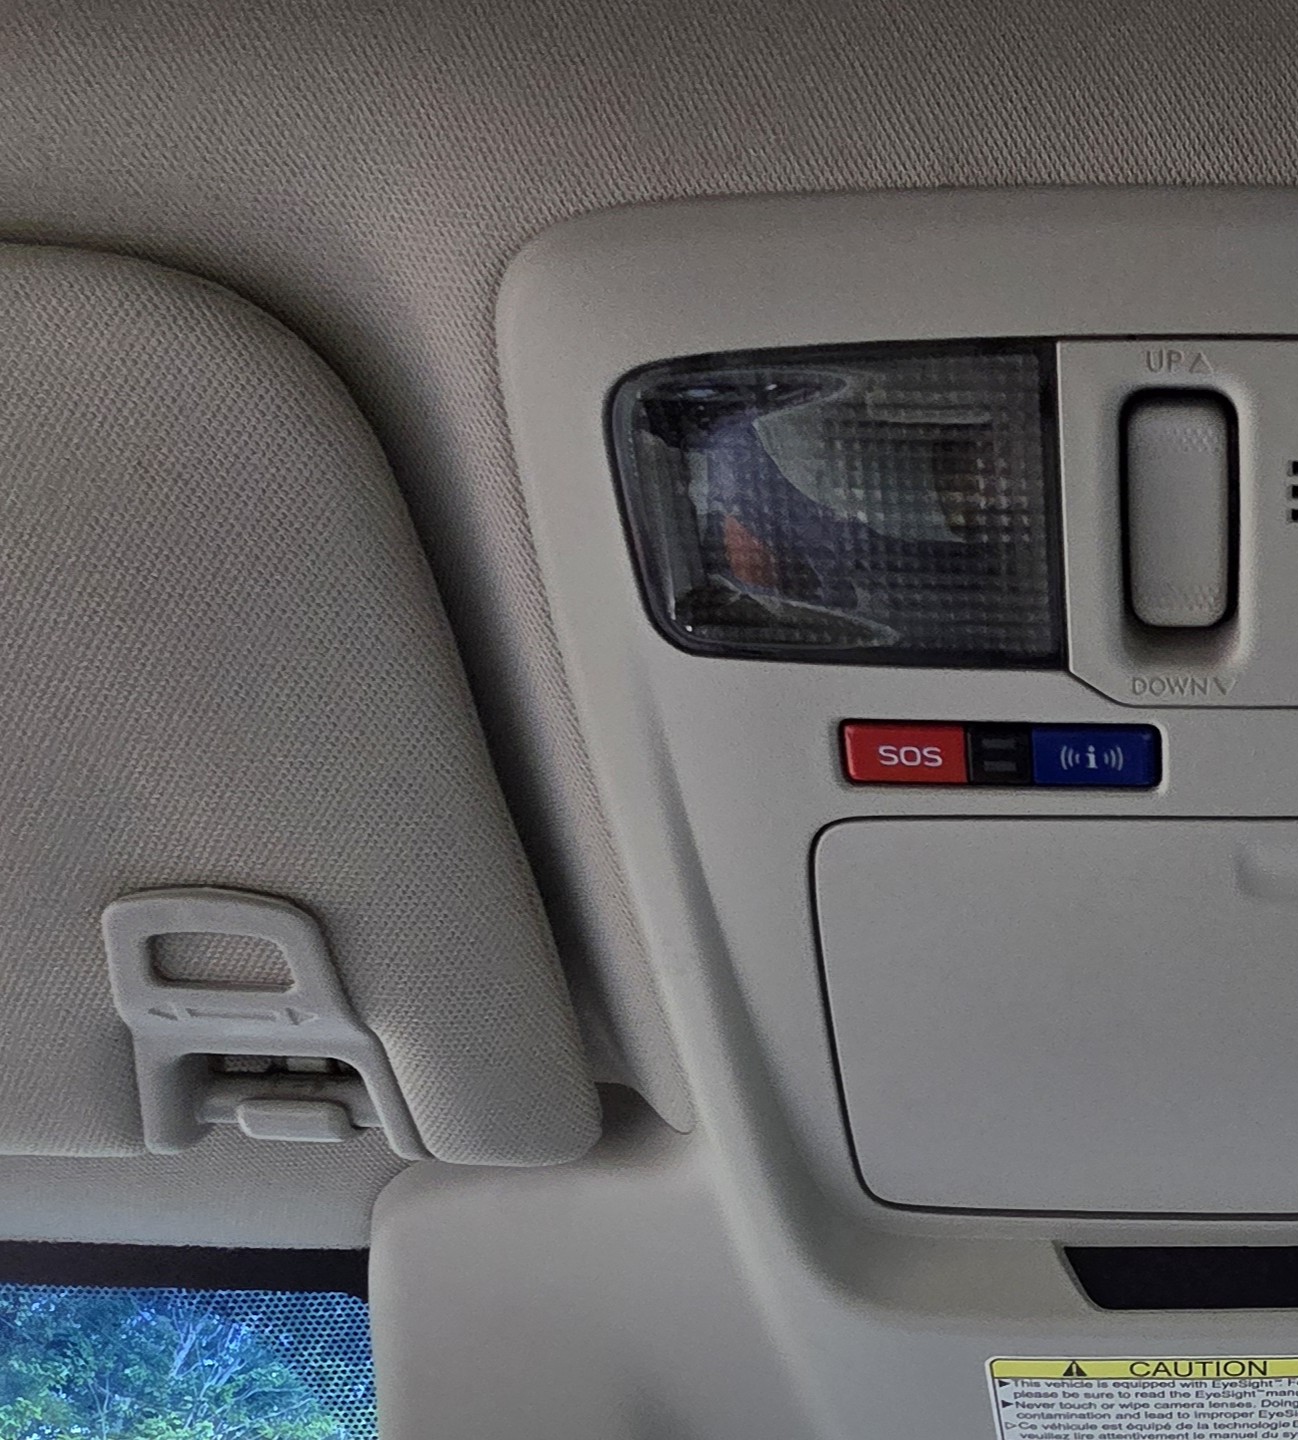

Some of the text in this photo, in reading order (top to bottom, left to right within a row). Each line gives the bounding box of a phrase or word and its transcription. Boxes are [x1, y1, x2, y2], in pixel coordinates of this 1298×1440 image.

[1146, 349, 1183, 373] UP
[1132, 677, 1208, 696] DOWN
[879, 745, 943, 767] SOS
[1129, 1360, 1268, 1378] CAUTION
[1013, 1380, 1041, 1388] This
[1045, 1380, 1093, 1388] vehicle
[1097, 1380, 1108, 1388] is
[1112, 1381, 1175, 1390] equipped
[1180, 1380, 1207, 1388] with
[1014, 1390, 1058, 1399] please
[1062, 1391, 1079, 1399] be
[1118, 1391, 1131, 1399] to
[1135, 1390, 1165, 1399] read
[1170, 1390, 1191, 1398] the
[1015, 1401, 1055, 1409] Never
[1060, 1401, 1096, 1409] touch
[1119, 1401, 1150, 1410] wipe
[1154, 1401, 1204, 1409] camera
[1016, 1411, 1111, 1420] contamination
[1115, 1411, 1140, 1419] and
[1145, 1411, 1173, 1419] lead
[1177, 1411, 1190, 1419] to
[1194, 1411, 1254, 1420] improper
[1018, 1421, 1037, 1430] Ce
[1102, 1422, 1122, 1430] est
[1176, 1422, 1193, 1430] de
[1197, 1422, 1209, 1430] la
[1213, 1420, 1290, 1431] technologie
[1074, 1432, 1095, 1440] lire
[1098, 1431, 1189, 1440] attentivement
[1193, 1431, 1205, 1439] le
[1209, 1431, 1257, 1439] manuel
[1262, 1430, 1278, 1438] du
